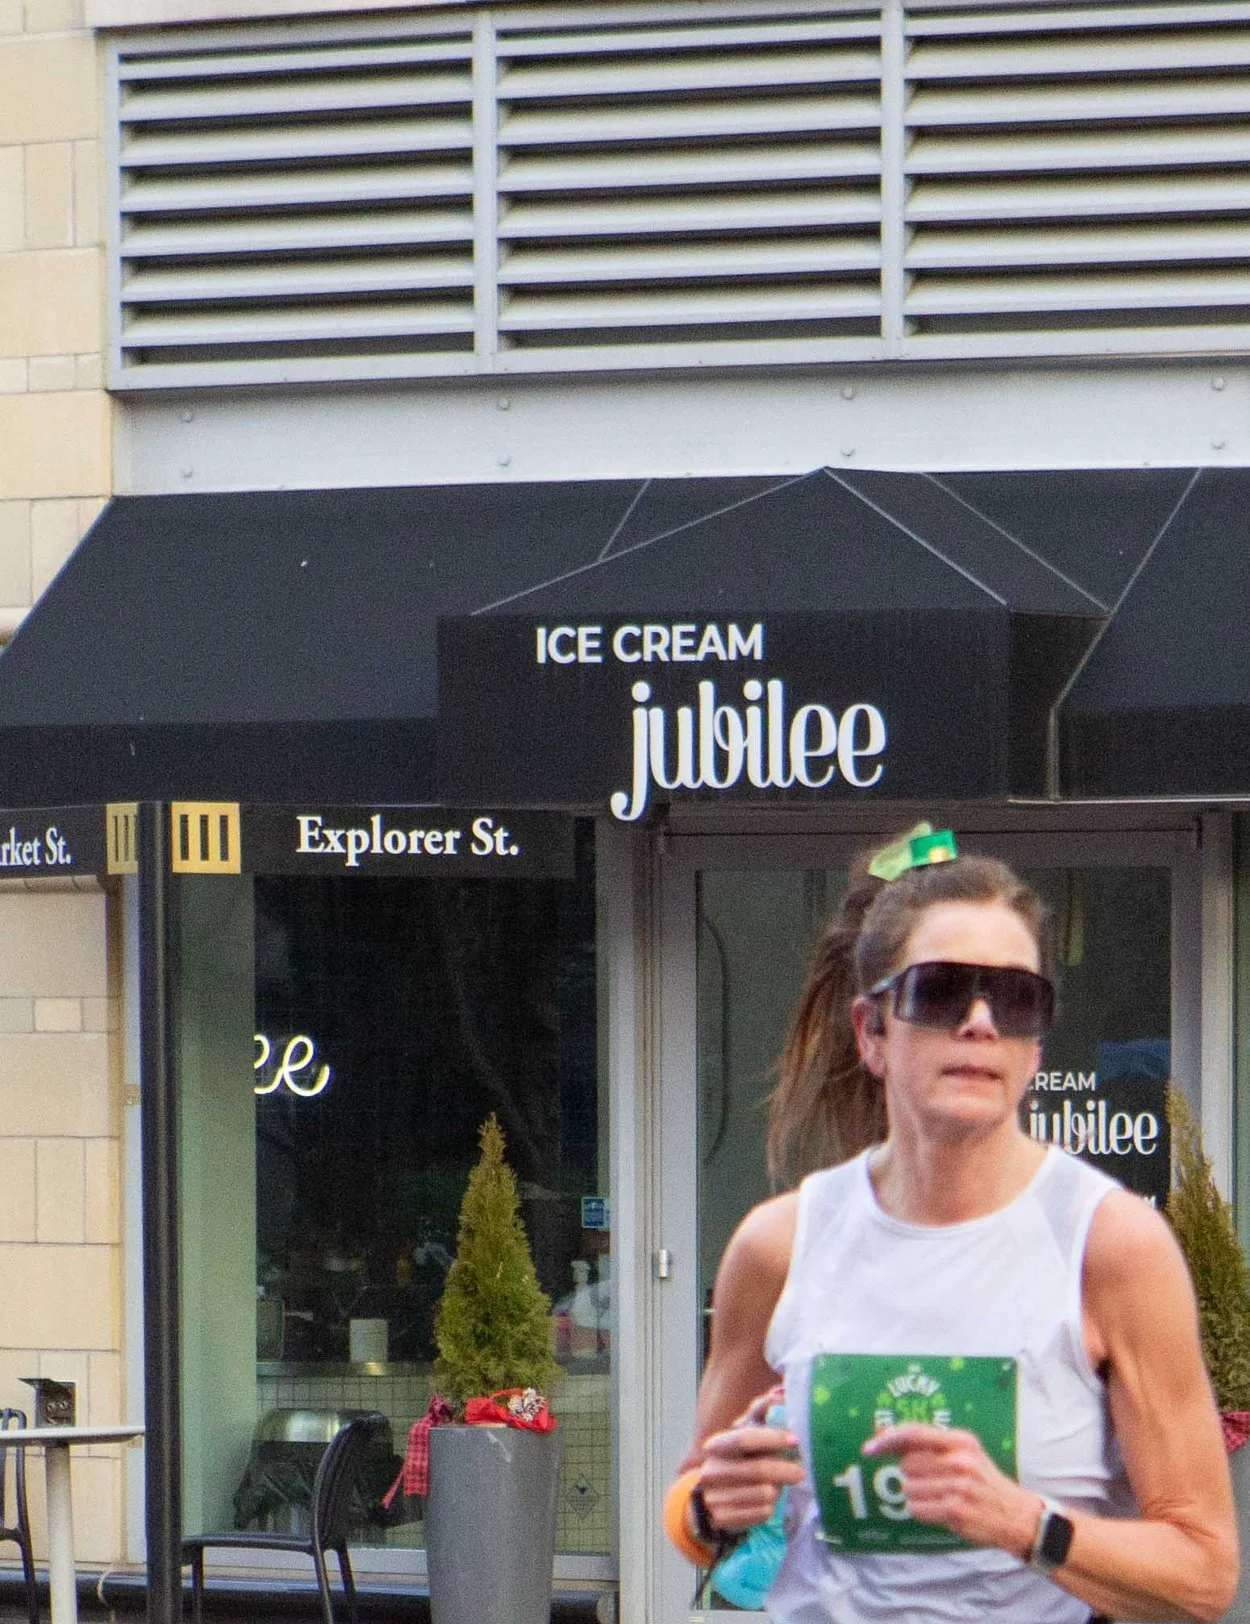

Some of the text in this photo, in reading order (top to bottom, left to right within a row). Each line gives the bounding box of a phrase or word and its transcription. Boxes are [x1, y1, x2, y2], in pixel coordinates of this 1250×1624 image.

[536, 623, 763, 664] ICE CREAM
[610, 679, 887, 822] jubilee
[45, 827, 72, 865] St.
[296, 815, 520, 867] Explorer St.
[1029, 1071, 1096, 1091] REAM
